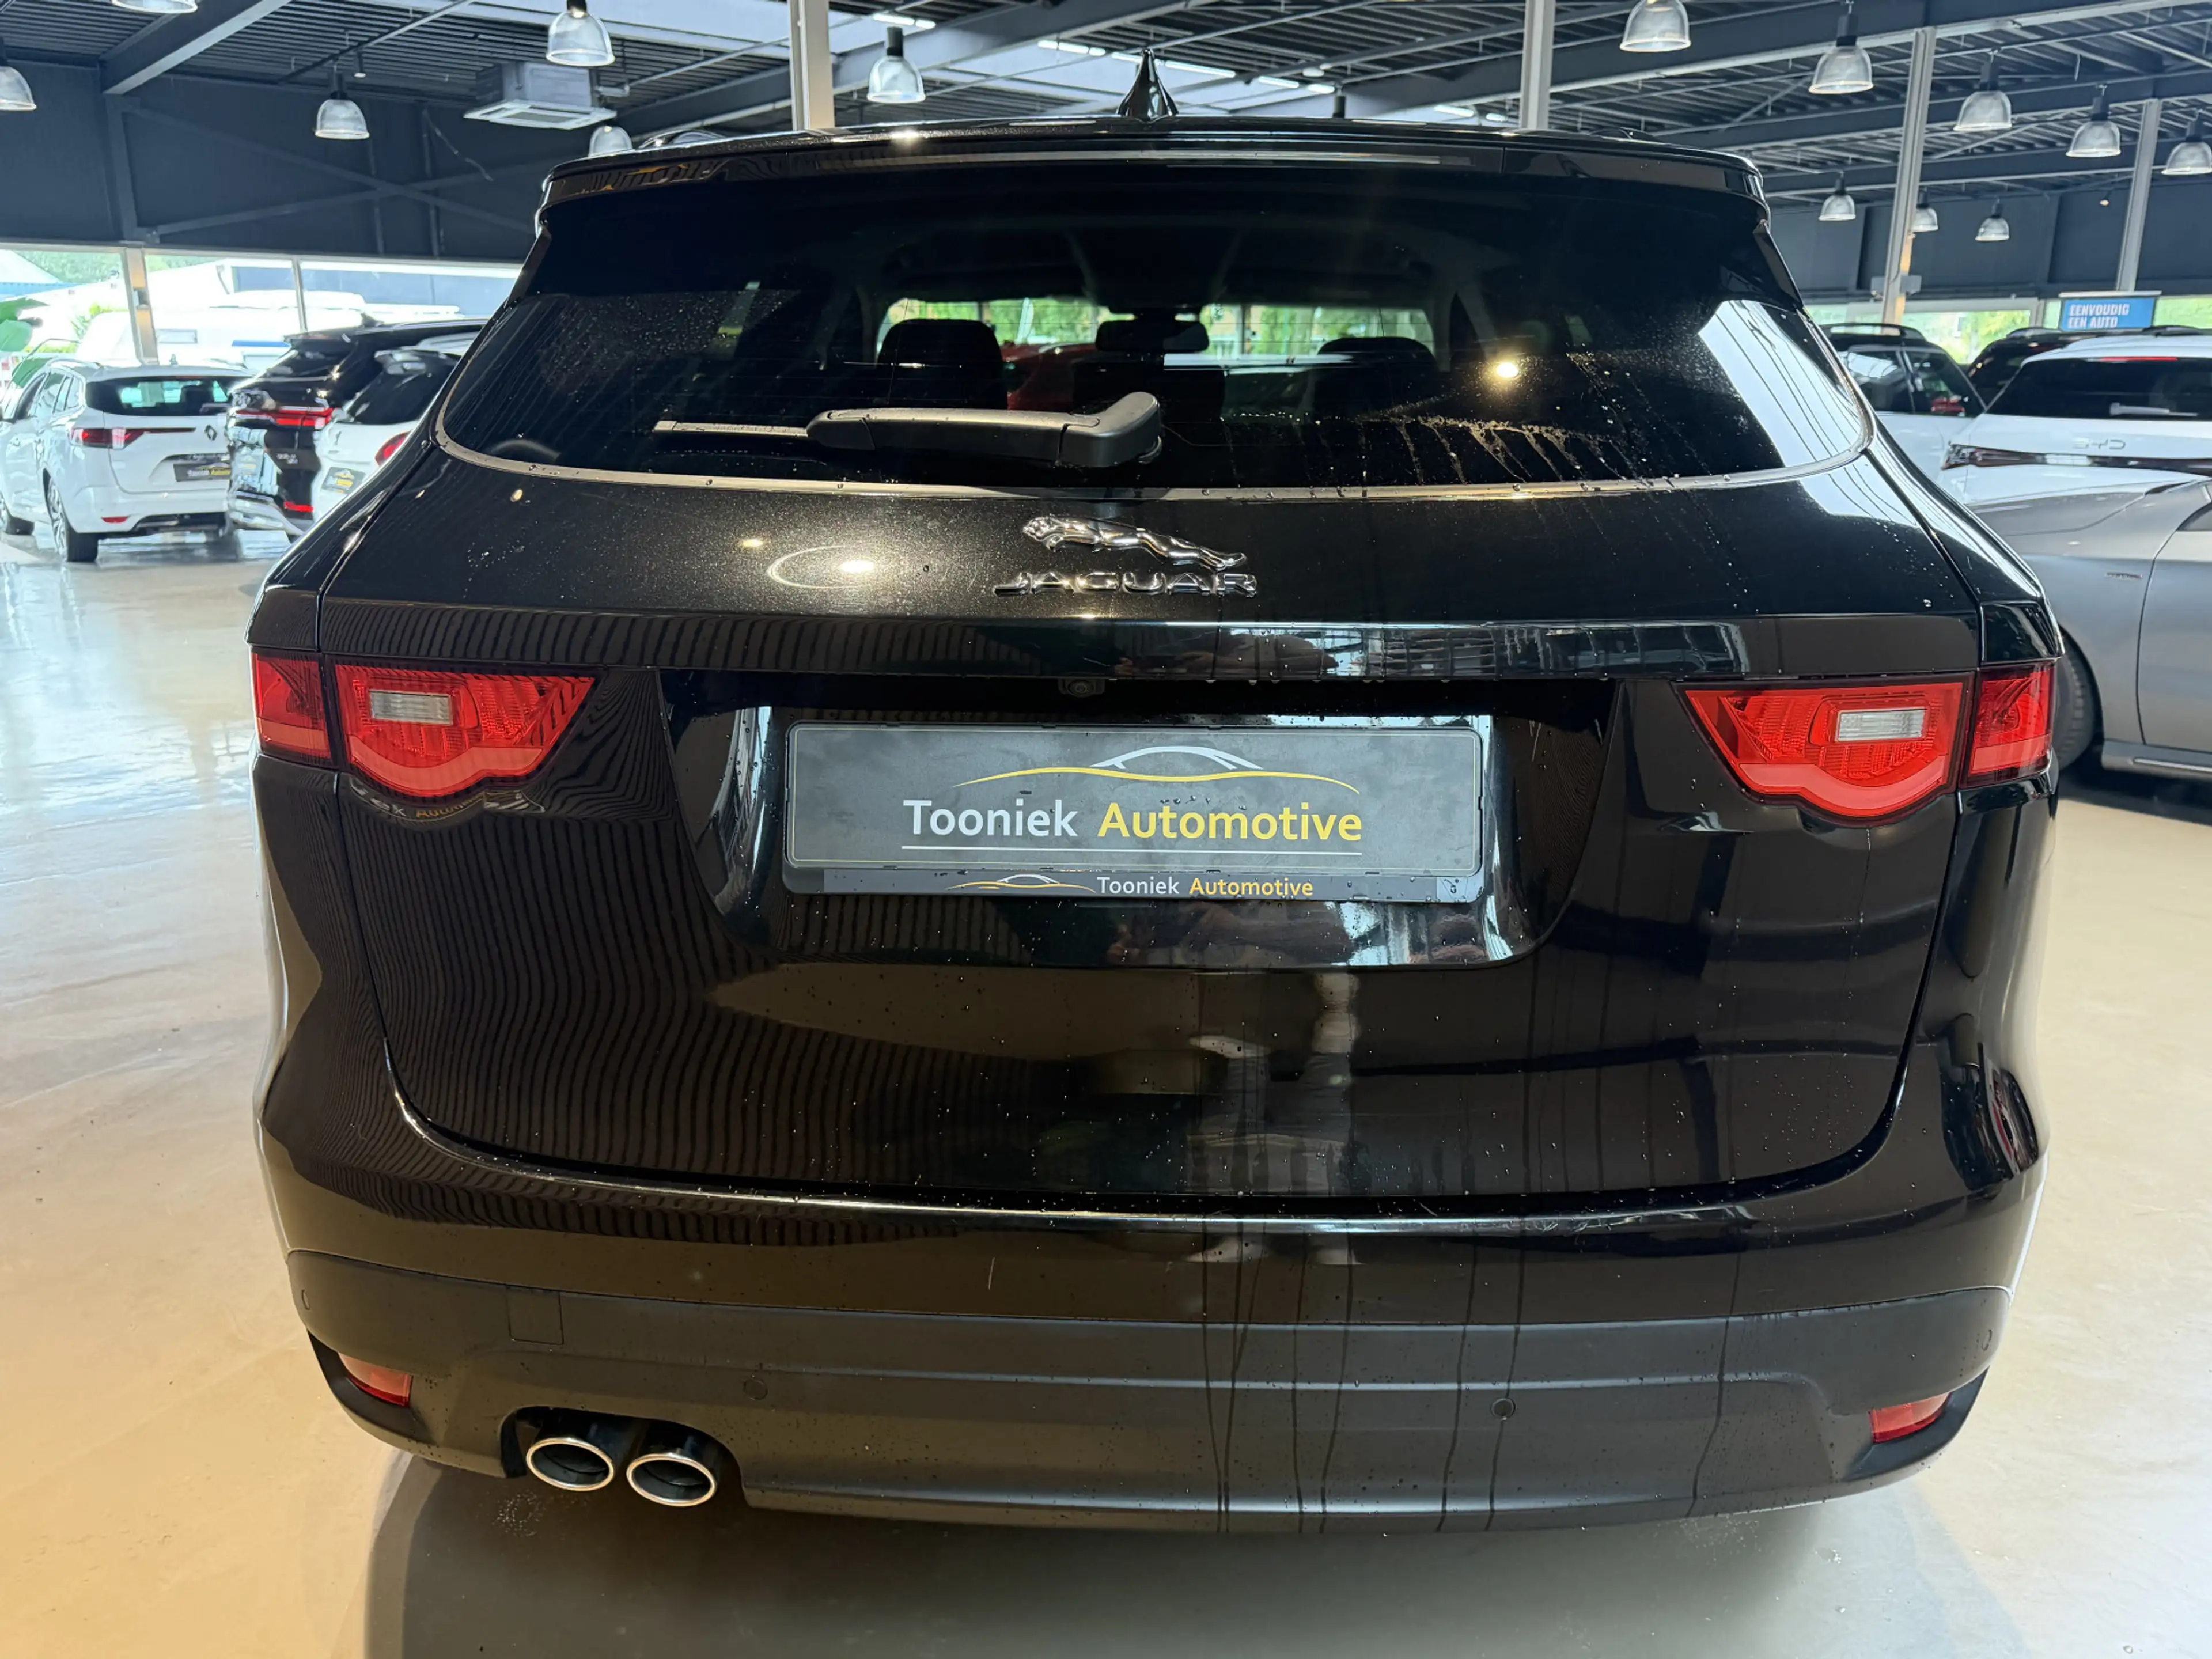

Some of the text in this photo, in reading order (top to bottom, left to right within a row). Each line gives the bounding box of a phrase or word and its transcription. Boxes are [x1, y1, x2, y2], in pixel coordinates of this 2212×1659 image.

[2070, 304, 2130, 316] EENVOUDIG
[2068, 316, 2118, 328] EEN AUTO
[994, 572, 1257, 598] JAGUAR
[903, 798, 1362, 841] Tooniek Automotive
[1097, 876, 1314, 896] Tooniek Automotive
